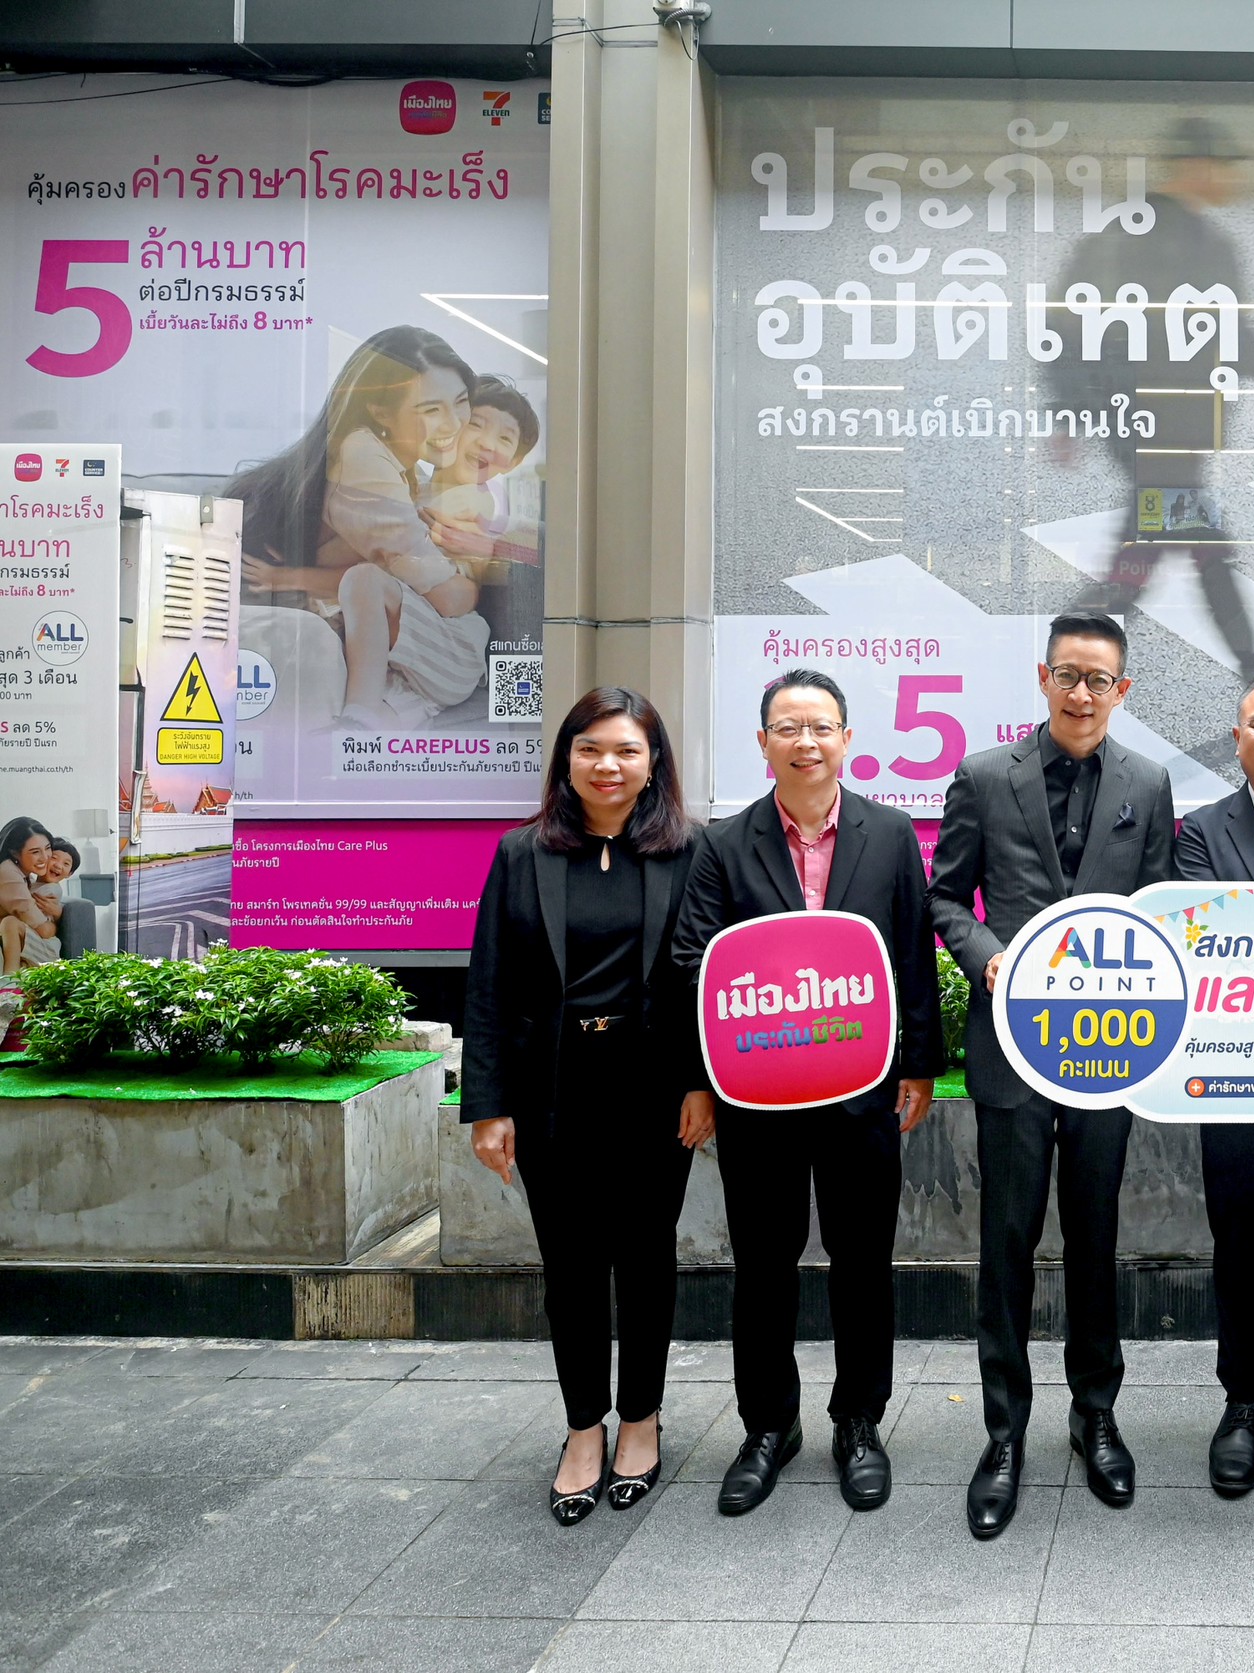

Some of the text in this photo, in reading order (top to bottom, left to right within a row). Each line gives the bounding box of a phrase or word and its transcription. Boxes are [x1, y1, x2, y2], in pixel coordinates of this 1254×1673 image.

[404, 95, 452, 109] เมืองไทย
[28, 150, 510, 204] คุ้มครอง ค่ารักษาโรคมะเร็ง
[751, 118, 1156, 235] ประกัน
[139, 226, 306, 270] ล้านบาท
[138, 278, 306, 303] ต่อปีกรมธรรม์
[25, 239, 133, 378] 5
[138, 309, 249, 331] เบี้ยวันละไม่ถึง
[253, 311, 268, 331] 8
[754, 245, 1240, 402] อุบัติเหตุ
[757, 393, 1157, 439] สงกรานต์เบิกบานใจ
[37, 584, 46, 597] 8
[35, 622, 84, 642] ALL
[36, 641, 82, 651] member
[763, 629, 941, 665] คุ้มครองสูงสุด
[23, 670, 33, 685] 3
[38, 668, 78, 685] เดือน
[14, 691, 32, 700] บาท
[13, 721, 56, 733] ลด 5%
[173, 732, 212, 741] ระวังอันตราย
[174, 741, 211, 752] ไฟฟ้าแรงสูง
[342, 736, 519, 754] พิมพ์ CAREPLUS ลด
[342, 757, 521, 773] เมื่อเลือกชำระเบี้ยประกันภัยรายปี
[251, 838, 388, 851] โครงการเมืองไทย Care Plus
[246, 897, 459, 912] สมาร์ท โพรเทคชั่น 99/99 และสัญญาเพิ่มเติม
[291, 913, 413, 927] ก่อนตัดสินใจทำประกันภัย
[1048, 927, 1153, 970] ALL
[1046, 975, 1156, 992] POINT
[717, 968, 875, 1021] เมืองไทย
[736, 1015, 863, 1054] ประกันชีวิต
[1032, 1008, 1156, 1054] 1,000
[1059, 1059, 1131, 1079] คะแนน
